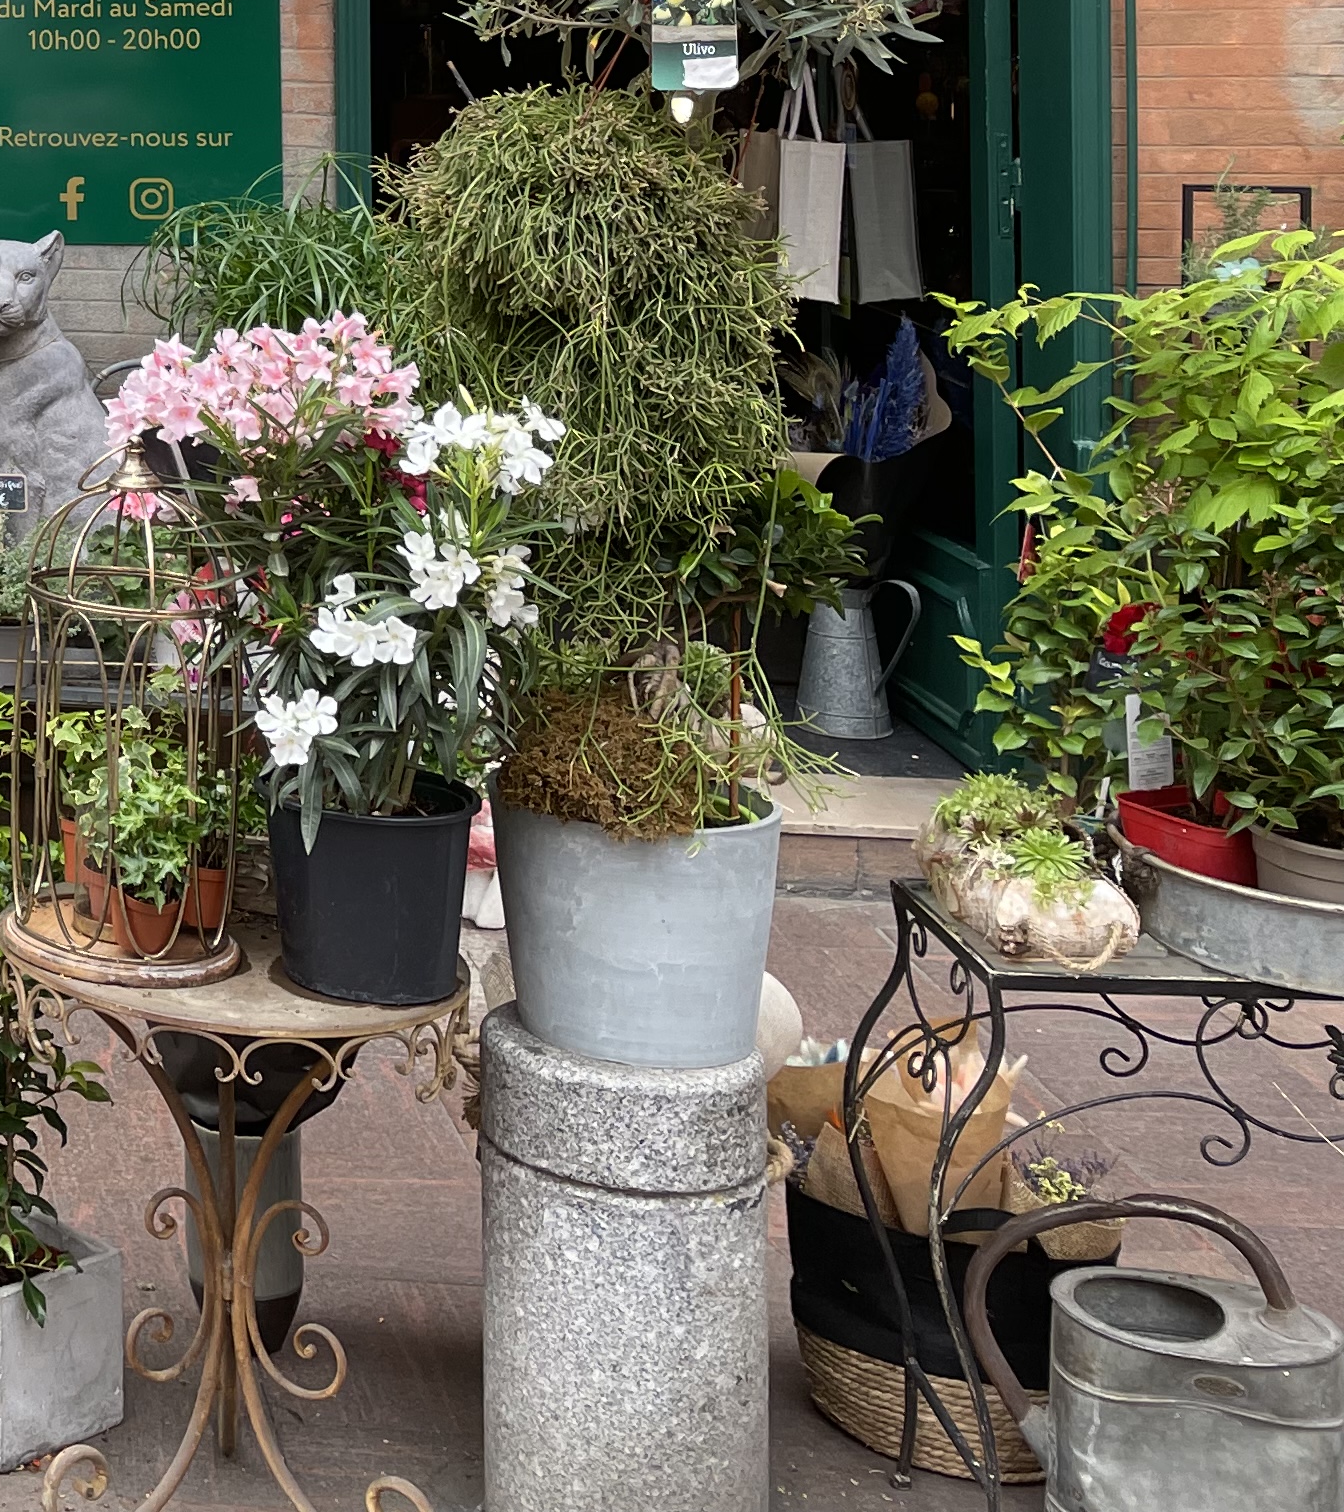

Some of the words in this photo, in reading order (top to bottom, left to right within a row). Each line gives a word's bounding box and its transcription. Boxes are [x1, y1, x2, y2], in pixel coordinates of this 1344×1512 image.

[109, 3, 137, 18] au
[28, 29, 101, 51] 10h00
[123, 29, 201, 50] 20h00
[682, 42, 716, 55] Ulivo
[196, 132, 233, 147] sur
